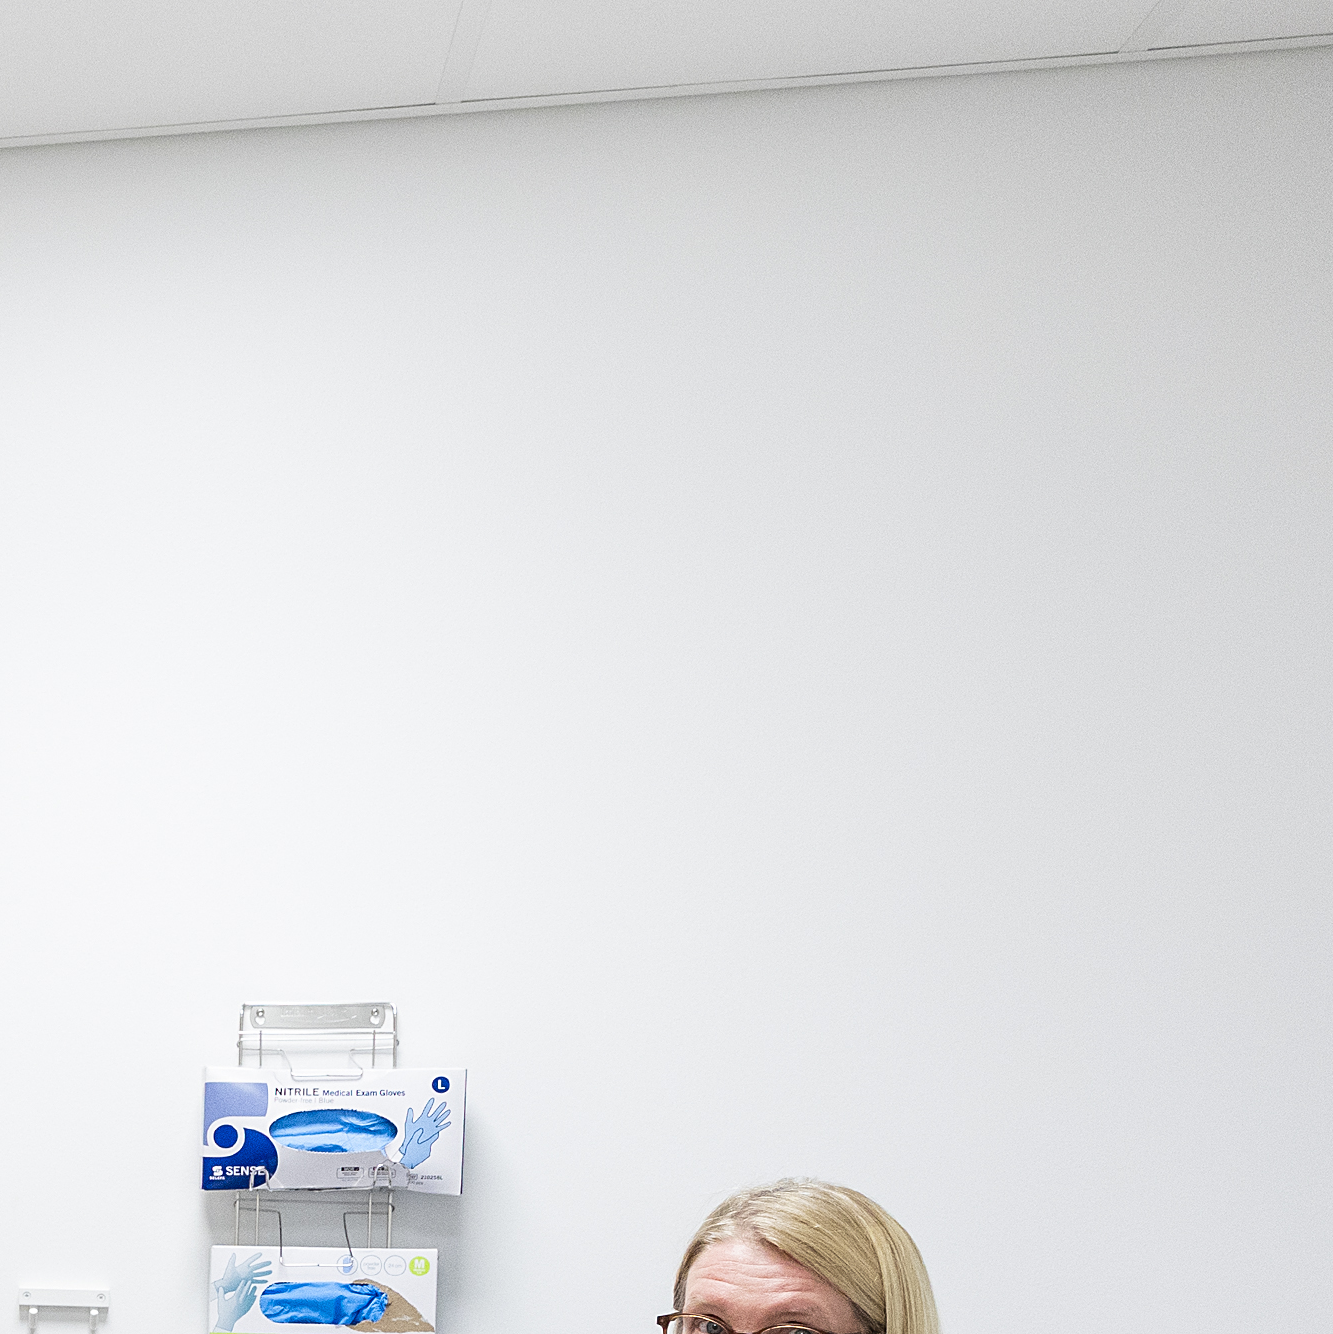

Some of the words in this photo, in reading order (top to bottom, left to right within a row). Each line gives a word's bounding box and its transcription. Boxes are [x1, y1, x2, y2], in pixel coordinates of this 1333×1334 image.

[437, 1080, 445, 1090] L
[274, 1087, 320, 1097] NITRILE
[322, 1089, 353, 1097] Medical
[356, 1089, 378, 1097] Exam
[379, 1089, 406, 1097] Gloves
[225, 1165, 266, 1176] SENSE
[414, 1259, 425, 1269] M
